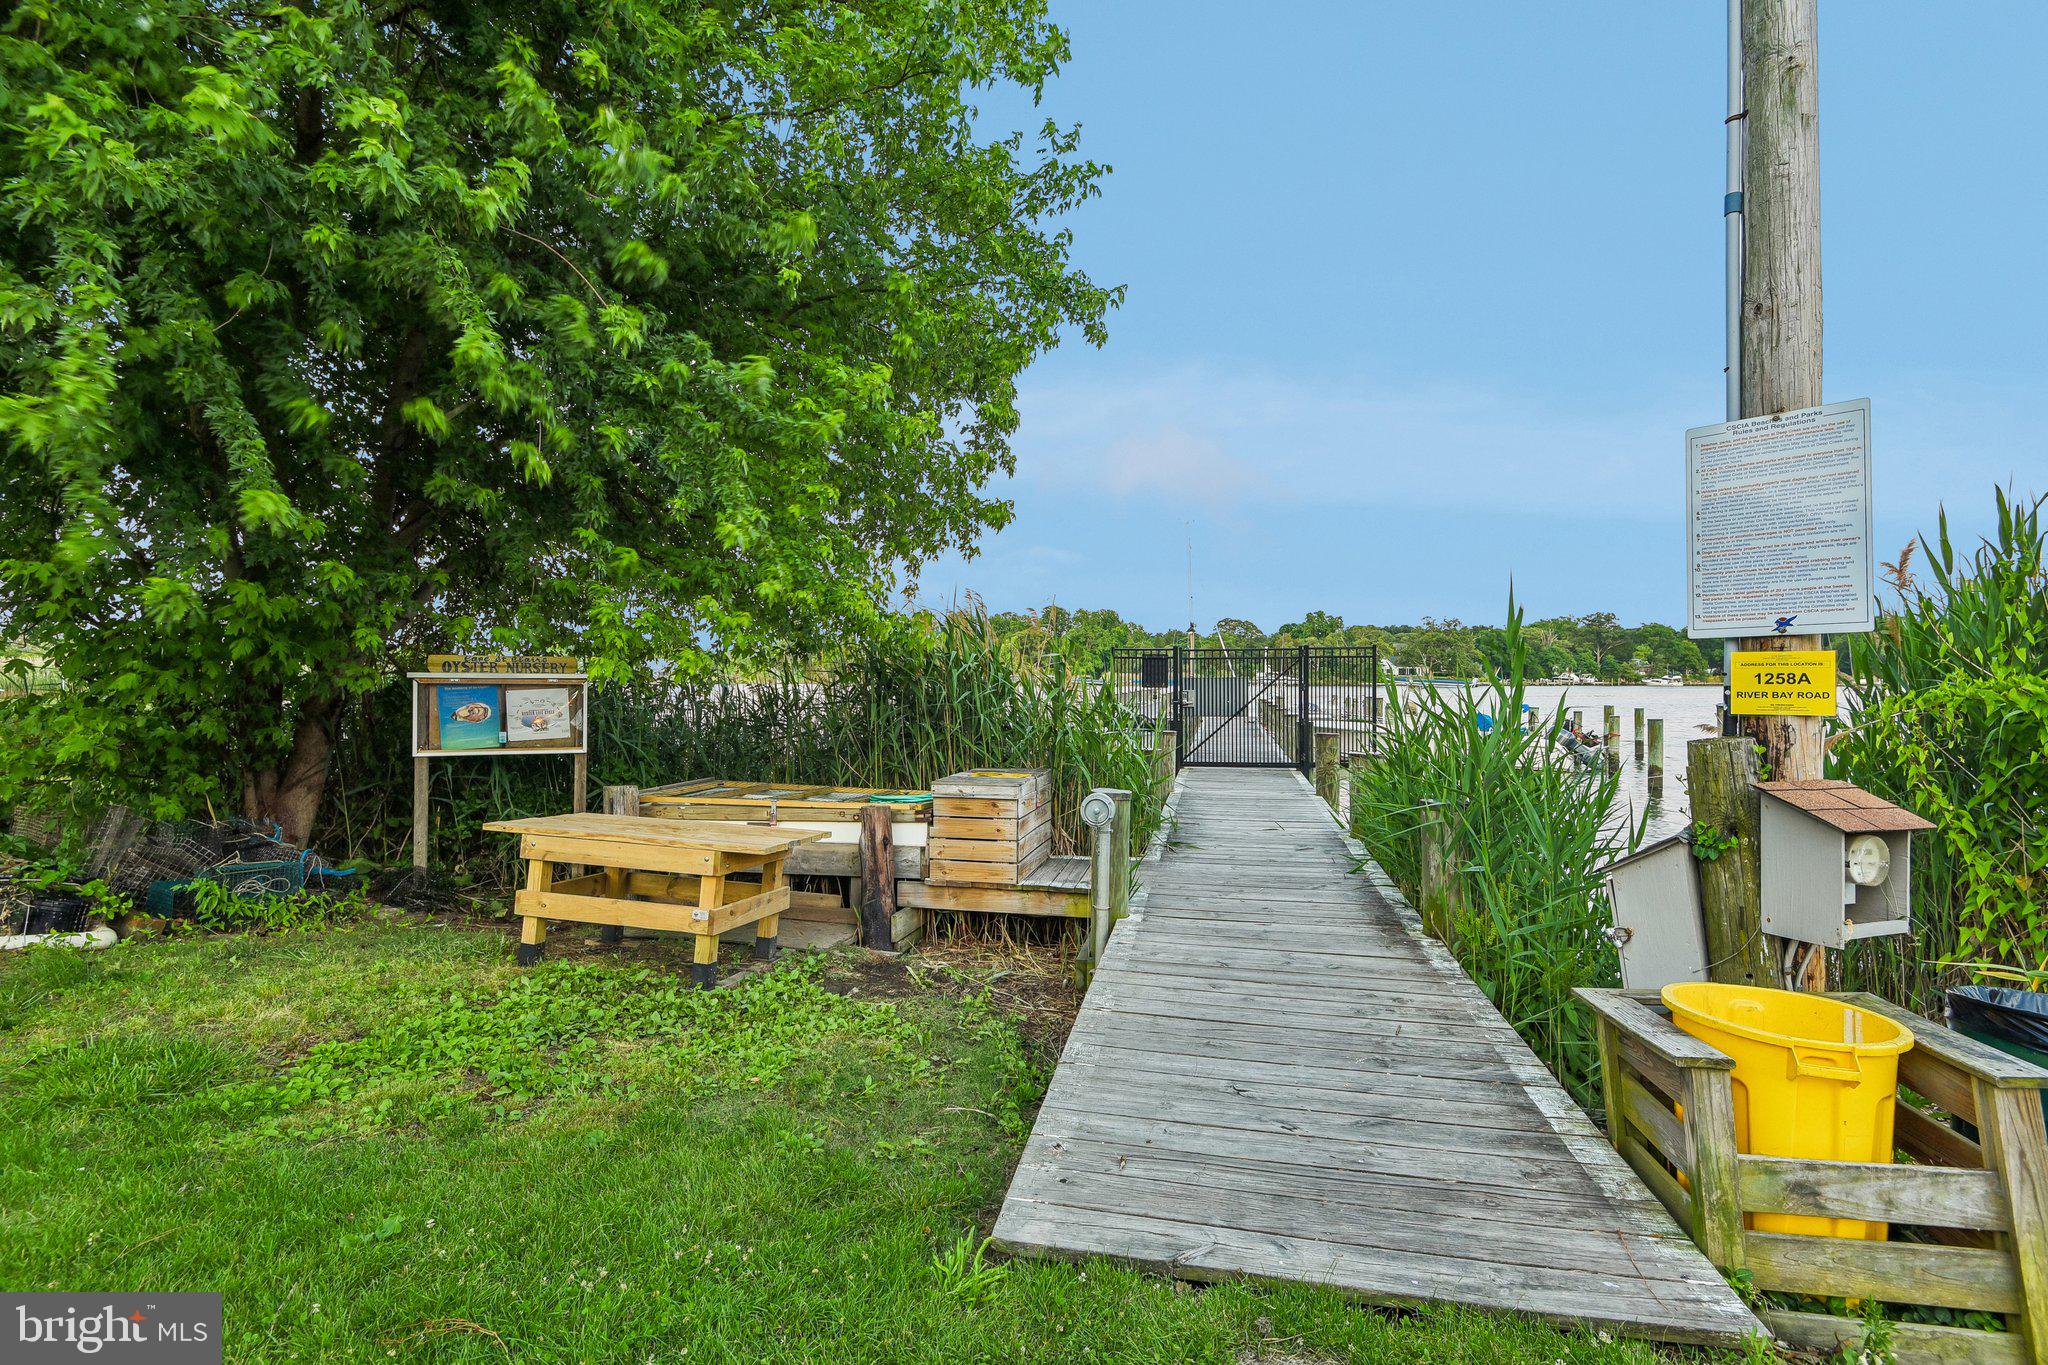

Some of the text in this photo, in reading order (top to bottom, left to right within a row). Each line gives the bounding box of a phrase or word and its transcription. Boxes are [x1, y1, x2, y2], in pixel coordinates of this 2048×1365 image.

[1726, 421, 1750, 431] CSCIA
[1801, 410, 1823, 419] Parks
[1732, 428, 1753, 436] Rules
[1770, 418, 1816, 431] Regulations
[442, 660, 568, 674] OYSTER NURSERY
[1754, 672, 1811, 684] 1258A
